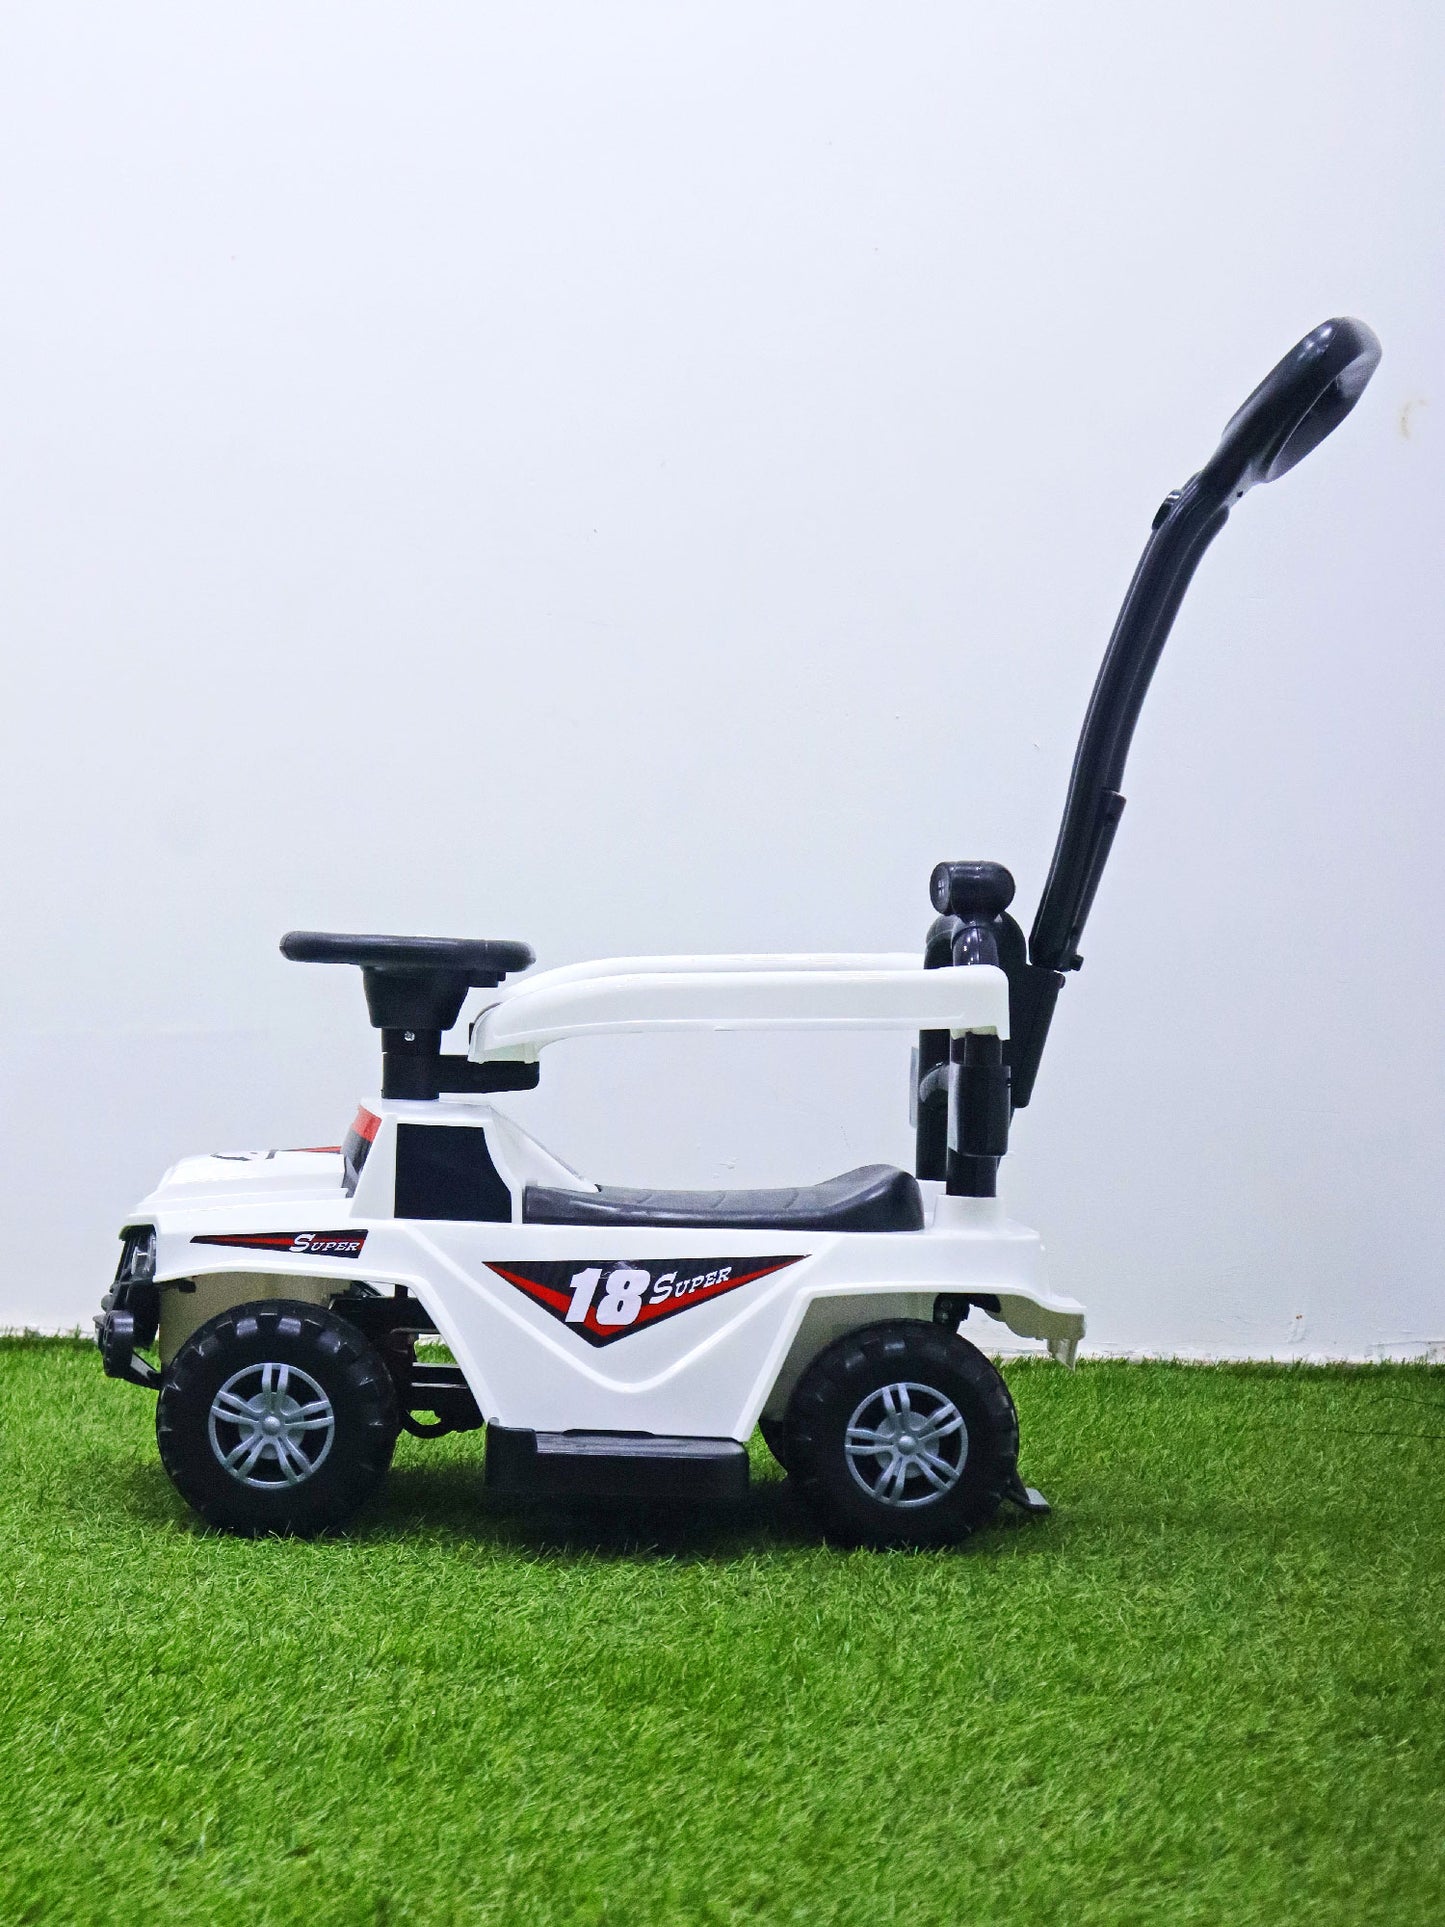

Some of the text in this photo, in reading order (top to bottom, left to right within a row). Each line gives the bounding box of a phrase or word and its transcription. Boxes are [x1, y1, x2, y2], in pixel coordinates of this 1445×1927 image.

[289, 1233, 360, 1252] SUPER
[565, 1266, 732, 1326] 18 SUPER
